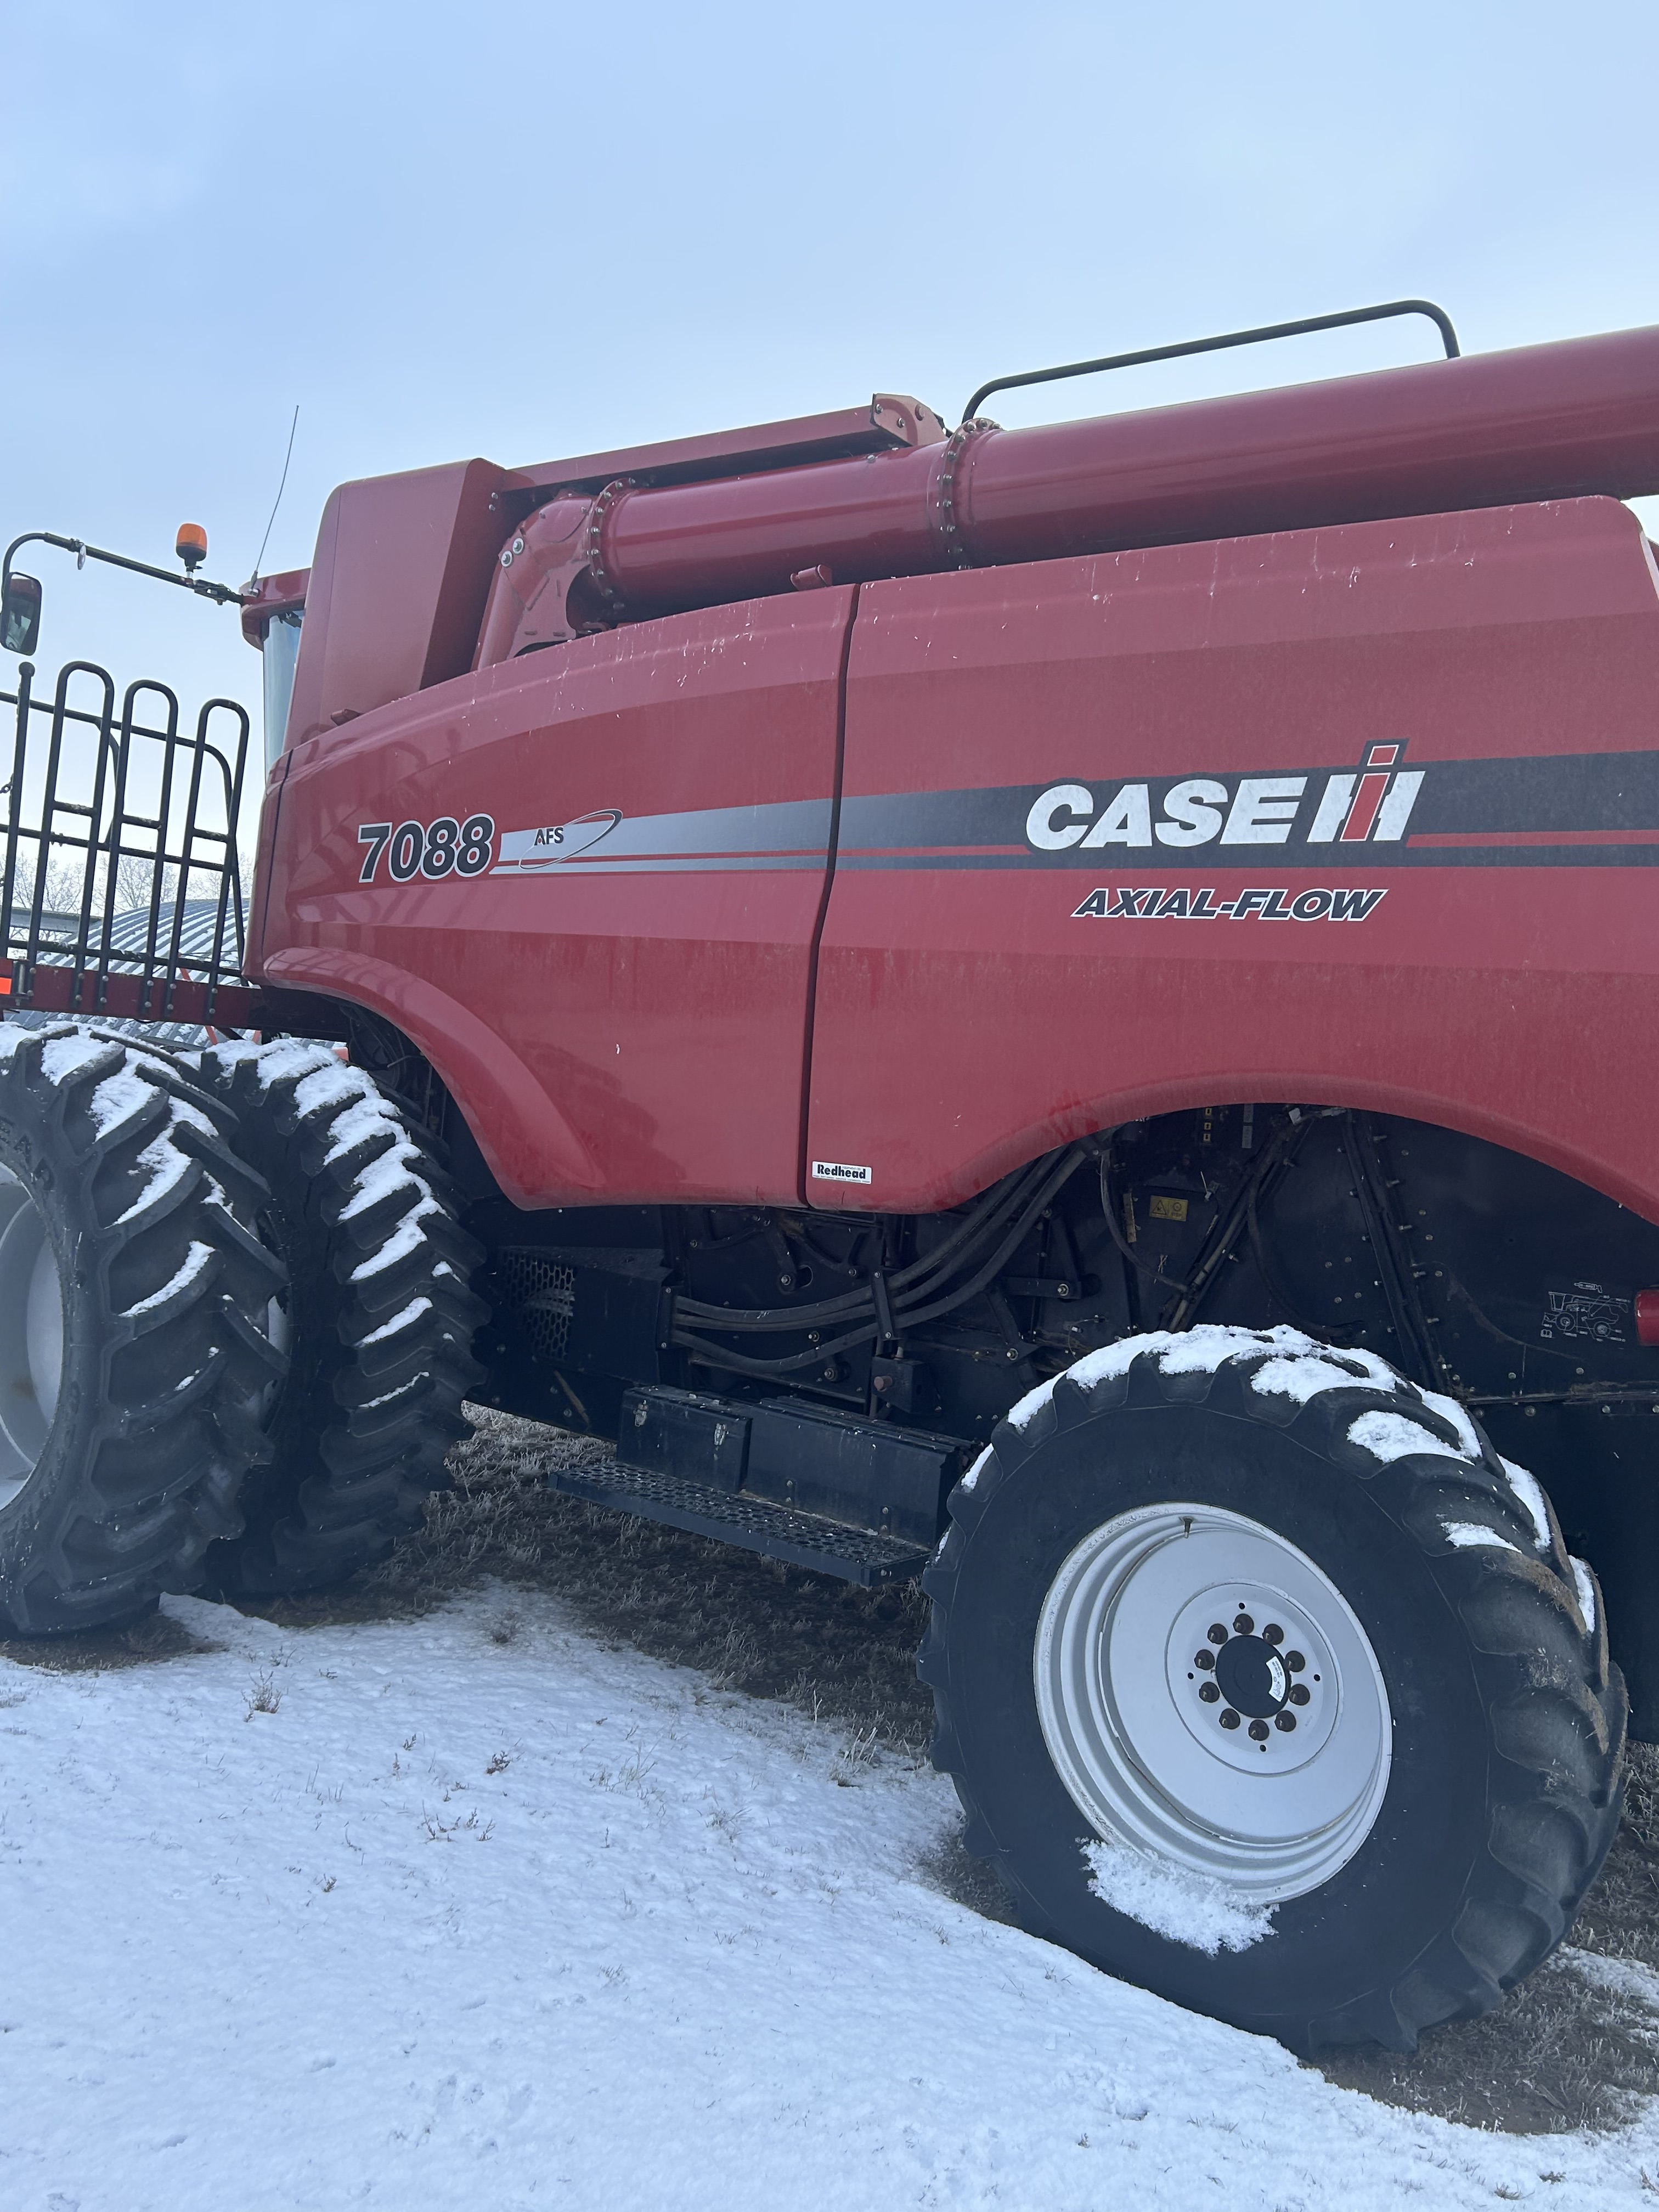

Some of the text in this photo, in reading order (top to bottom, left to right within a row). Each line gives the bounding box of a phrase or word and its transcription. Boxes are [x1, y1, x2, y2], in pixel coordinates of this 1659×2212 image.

[1026, 777, 1308, 850] CASE
[358, 813, 494, 883] 7088
[534, 827, 565, 846] AFS
[1070, 888, 1389, 922] AXIAL-FLOW
[817, 1164, 866, 1179] Redhead
